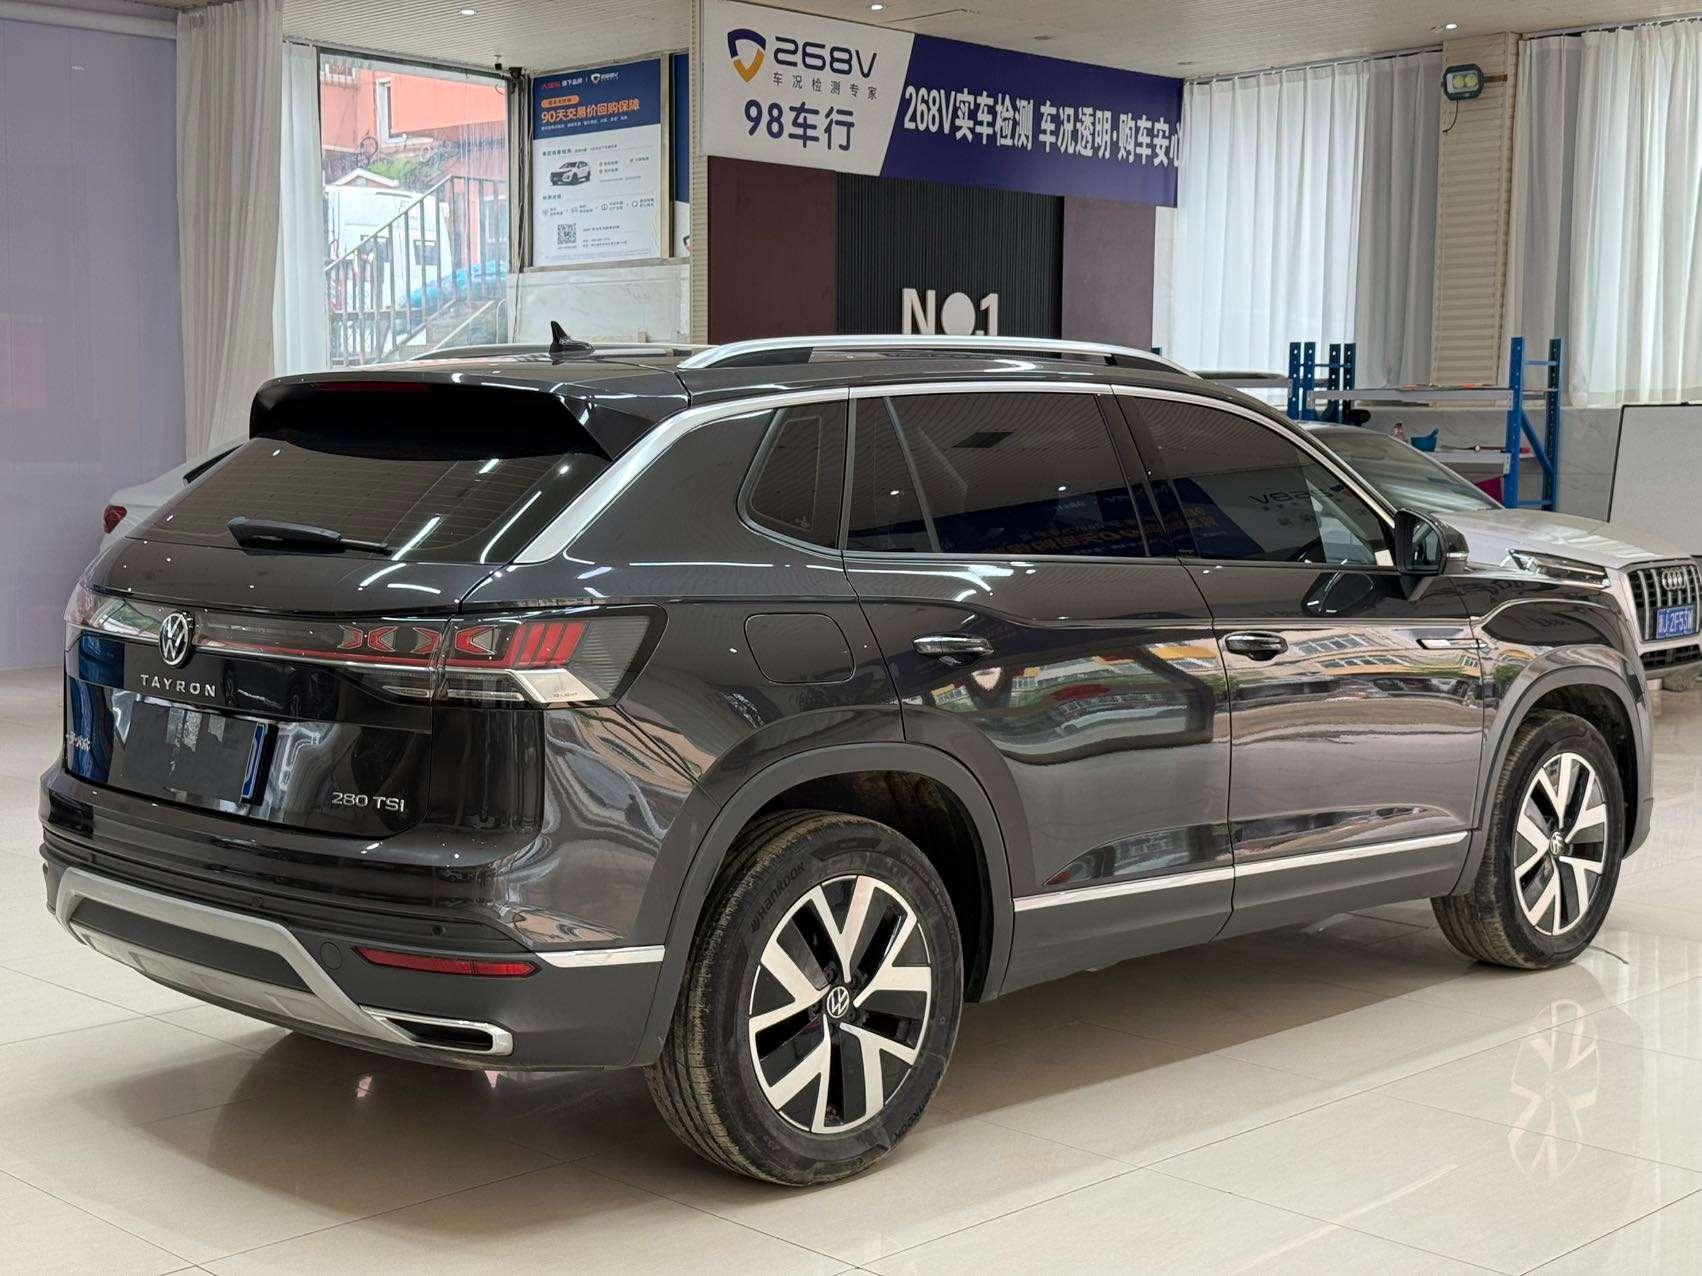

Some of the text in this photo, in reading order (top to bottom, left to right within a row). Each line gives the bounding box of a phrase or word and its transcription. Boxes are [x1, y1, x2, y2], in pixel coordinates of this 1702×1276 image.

[773, 36, 877, 79] 268V
[773, 71, 878, 100] 车况检测专家
[744, 99, 855, 151] 98车行
[903, 85, 1034, 151] 268V实车检测
[140, 674, 216, 698] TAYRON
[332, 792, 405, 812] 280 TSI
